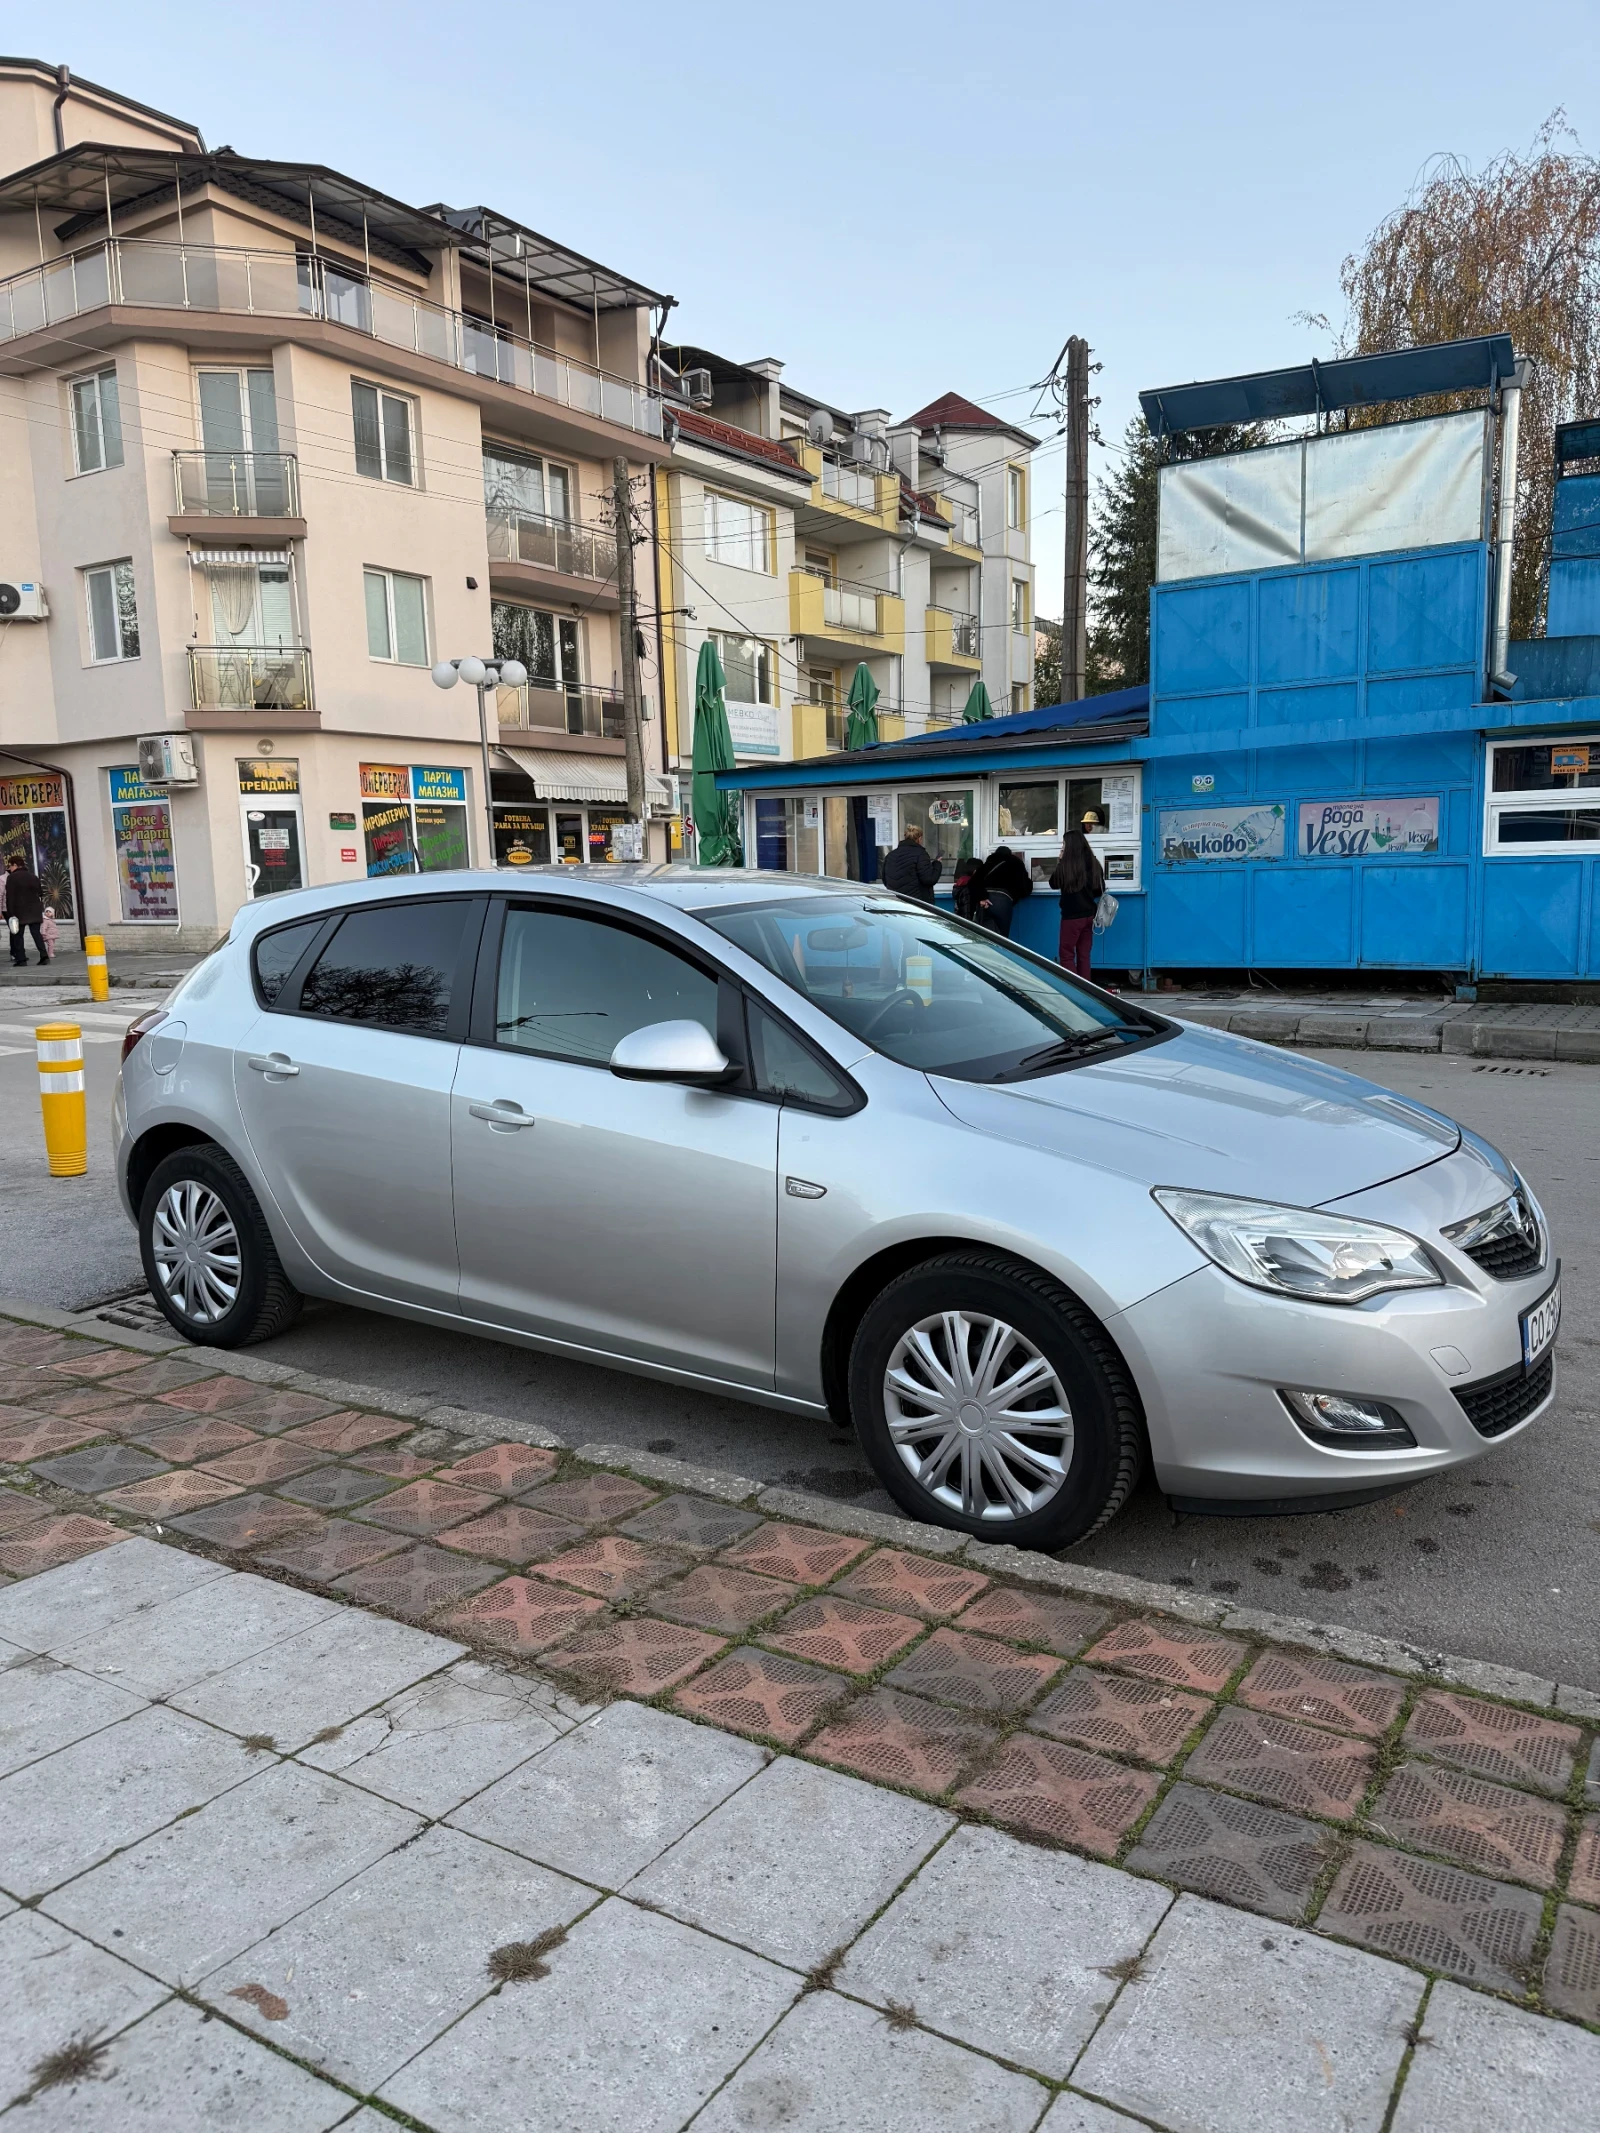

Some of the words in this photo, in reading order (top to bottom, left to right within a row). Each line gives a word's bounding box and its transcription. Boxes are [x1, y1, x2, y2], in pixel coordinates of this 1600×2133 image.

[360, 768, 409, 794] ОЙЕРВЕРКИ
[423, 771, 452, 784] ПАРТИ
[240, 780, 298, 792] ТРЕЙДИНГ
[418, 785, 459, 798] МАГАЗИН
[1, 782, 62, 806] ОЙЕРВЕРК
[122, 814, 157, 829] Време
[161, 814, 168, 825] е
[363, 805, 410, 832] ИРОБАТЕРИИ
[120, 831, 132, 841] за
[1165, 833, 1247, 854] Бнково
[1306, 824, 1370, 854] Vesa
[1408, 831, 1430, 843] Vesa
